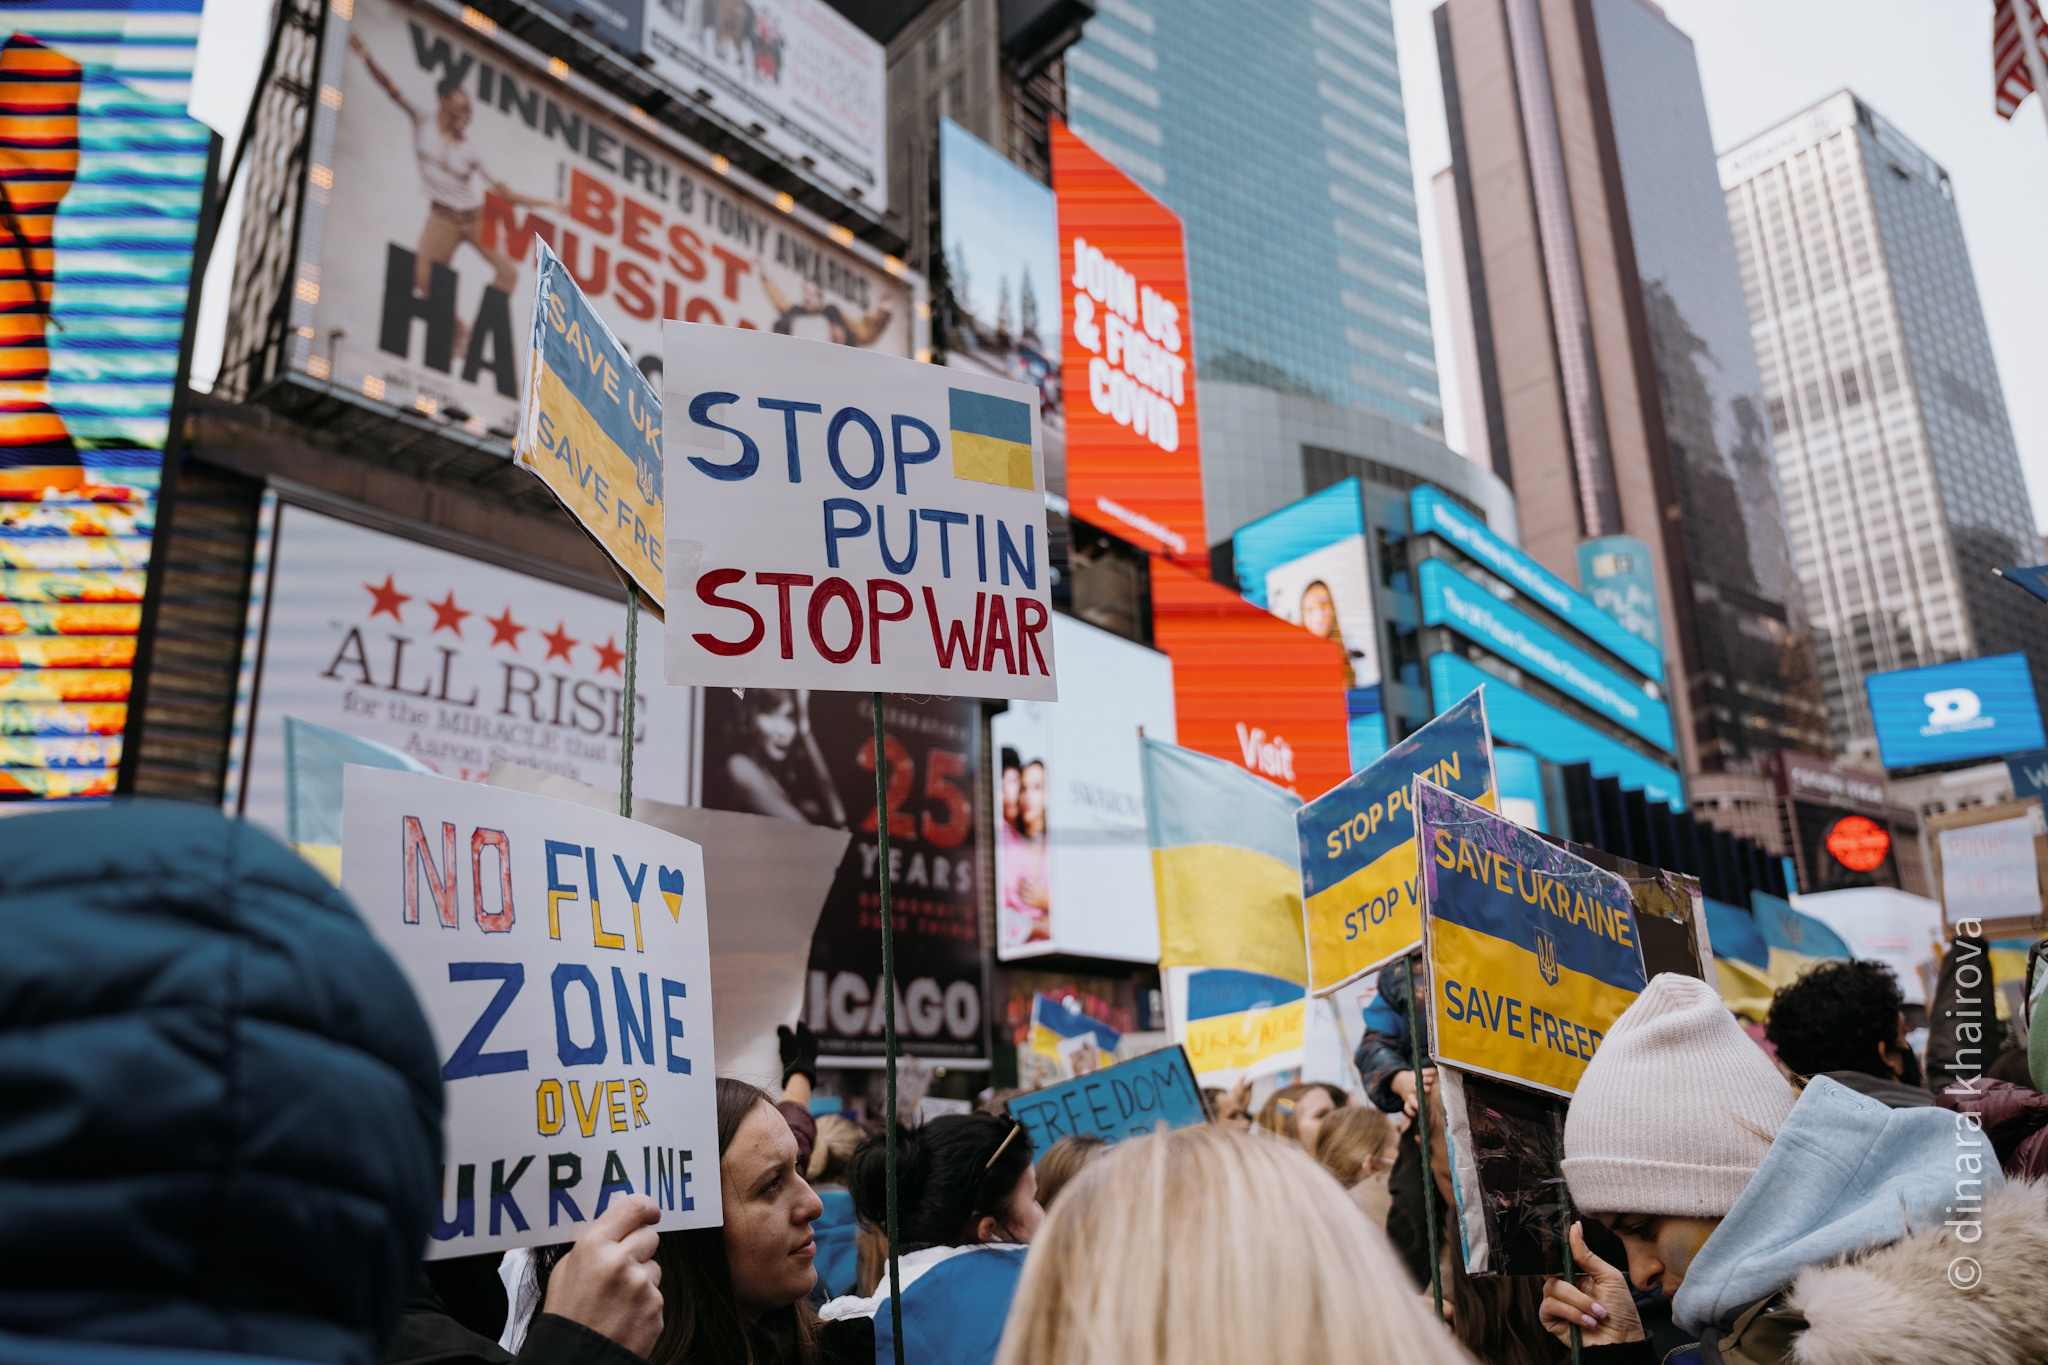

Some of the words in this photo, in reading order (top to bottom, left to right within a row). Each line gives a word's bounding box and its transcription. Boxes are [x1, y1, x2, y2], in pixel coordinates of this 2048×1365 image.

[568, 165, 752, 301] BEST
[685, 174, 709, 215] 8
[702, 188, 769, 253] TONY
[775, 230, 872, 312] AWARDS
[1072, 236, 1138, 325] JOIN
[1140, 284, 1182, 353] US
[548, 292, 620, 404] SAVE
[1073, 291, 1101, 354] &
[1105, 311, 1186, 407] FIGHT
[687, 390, 941, 495] STOP
[1088, 356, 1179, 452] COVID
[537, 410, 609, 515] SAVE
[823, 497, 1036, 590] PUTIN
[691, 567, 914, 664] STOP
[921, 584, 1051, 677] WAR
[343, 690, 383, 718] for
[387, 700, 430, 725] the
[437, 708, 557, 750] MIRACLE
[496, 658, 647, 743] RISE
[1235, 722, 1296, 782] Visit
[857, 734, 972, 849] 25
[1326, 802, 1383, 859] STOP
[402, 815, 516, 934] NO
[544, 838, 648, 954] FLY
[859, 842, 972, 893] YEARS
[1344, 886, 1399, 941] STOP
[1434, 828, 1513, 895] SAVE
[1517, 863, 1634, 949] UKRAINE
[442, 961, 692, 1081] ZONE
[1444, 979, 1525, 1040] SAVE
[536, 1077, 651, 1138] OVER
[428, 1145, 695, 1241] UKRAINE
